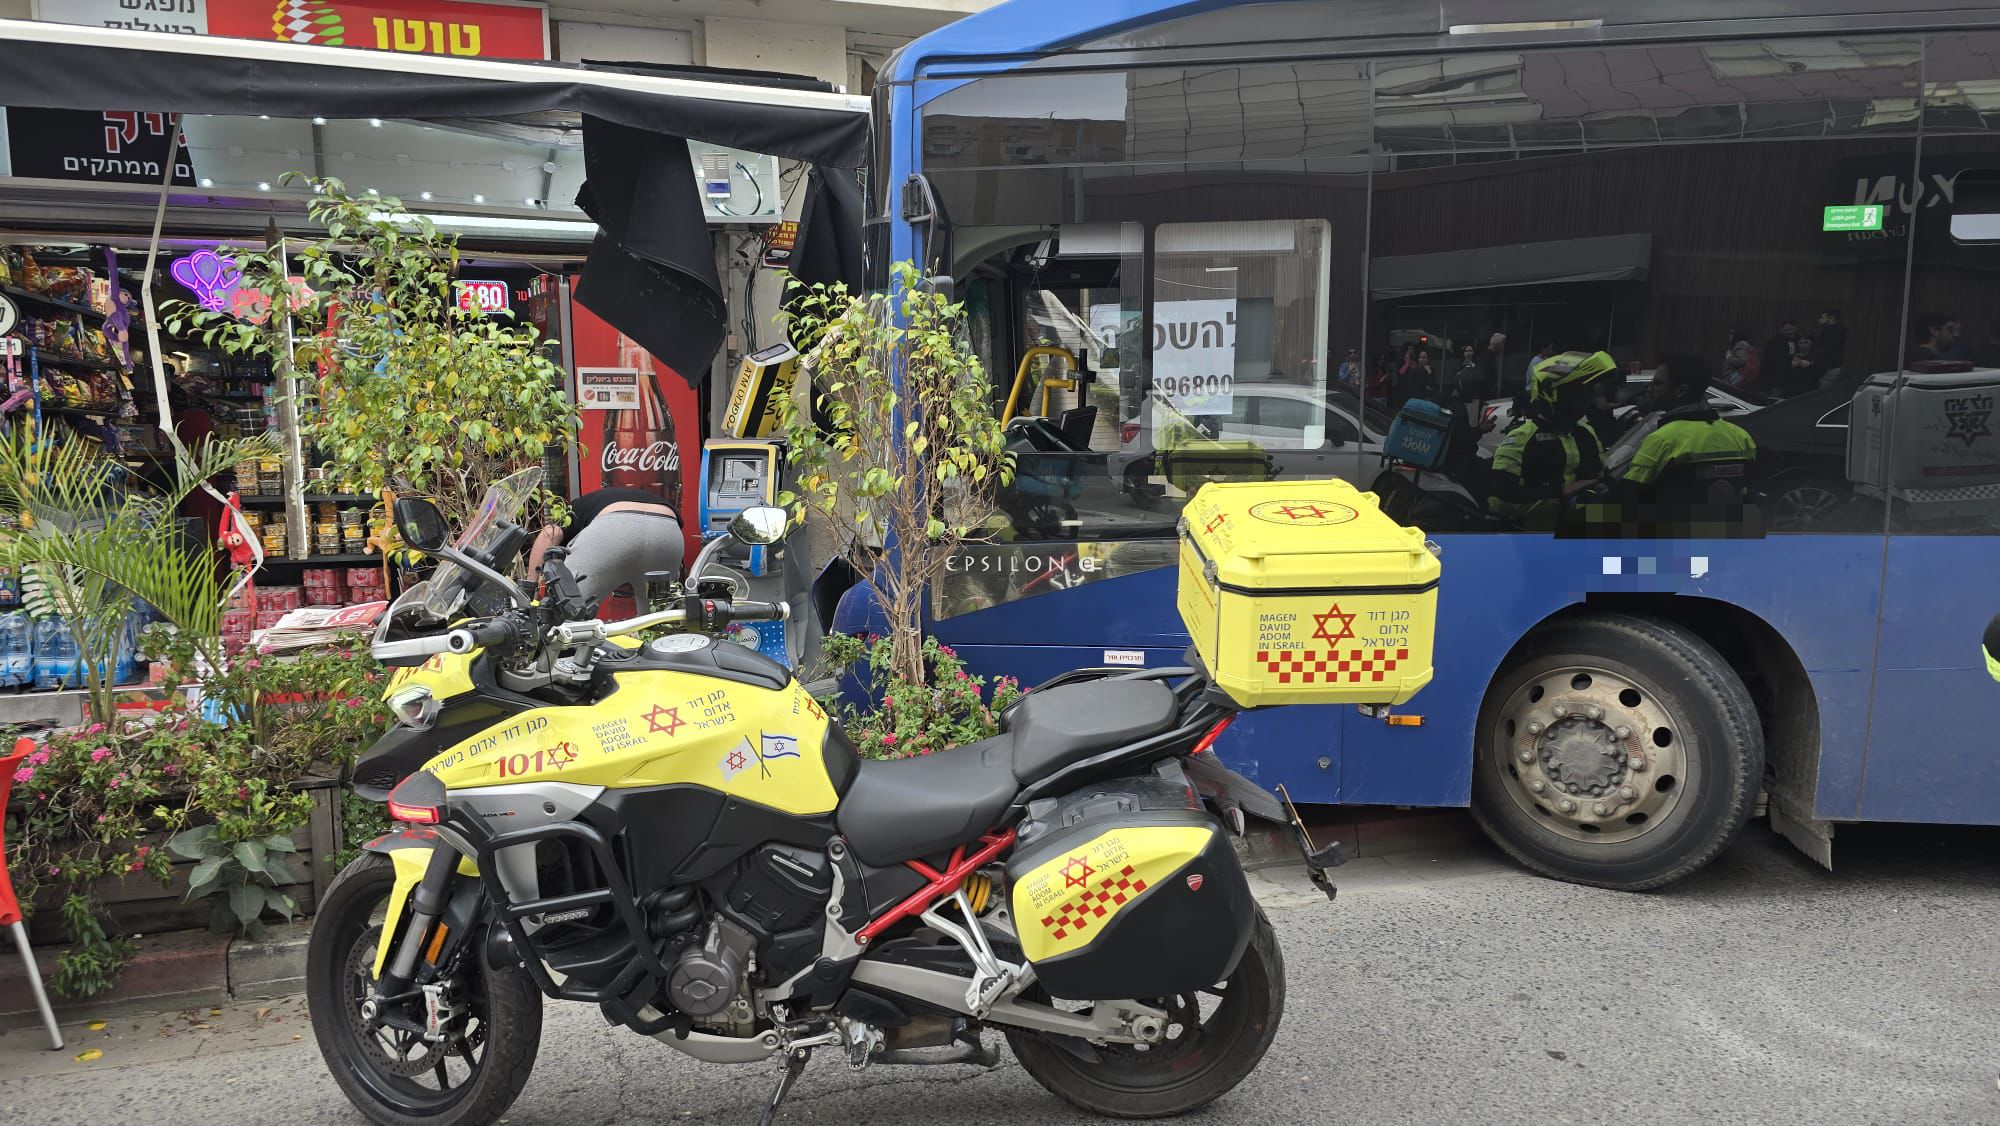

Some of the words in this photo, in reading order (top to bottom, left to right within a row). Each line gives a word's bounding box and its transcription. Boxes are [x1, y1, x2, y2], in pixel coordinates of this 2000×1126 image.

[372, 17, 481, 56] טוטו
[63, 156, 160, 176] ממתקים
[739, 366, 752, 388] ATM
[602, 440, 679, 472] Coca-Cola
[945, 555, 1065, 573] EPSILON
[1260, 613, 1297, 622] MAGEN
[1367, 611, 1385, 621] דוד
[1390, 610, 1410, 622] מגן
[1259, 623, 1291, 631] DAVID
[1379, 624, 1409, 635] אדום
[1259, 632, 1291, 641] ADOM
[1361, 636, 1408, 648] בישראל
[1258, 642, 1269, 650] IN
[1272, 641, 1305, 650] ISRAEL
[686, 697, 705, 709] דוד
[707, 689, 726, 705] מגן
[703, 701, 731, 717] אדום
[526, 716, 548, 735] מגן
[592, 718, 628, 732] MAGEN
[693, 712, 736, 730] בישראל
[501, 725, 521, 742] דוד
[595, 726, 626, 739] DAVID
[600, 732, 631, 746] ADOM
[469, 735, 497, 756] אדום
[603, 745, 615, 753] IN
[616, 736, 649, 750] ISRAEL
[425, 751, 464, 775] בישרא
[494, 750, 544, 778] 101
[1096, 851, 1130, 872] בישראל
[1031, 887, 1053, 903] ADOM
[1034, 900, 1043, 910] IN
[1043, 889, 1065, 906] ISRAEL
